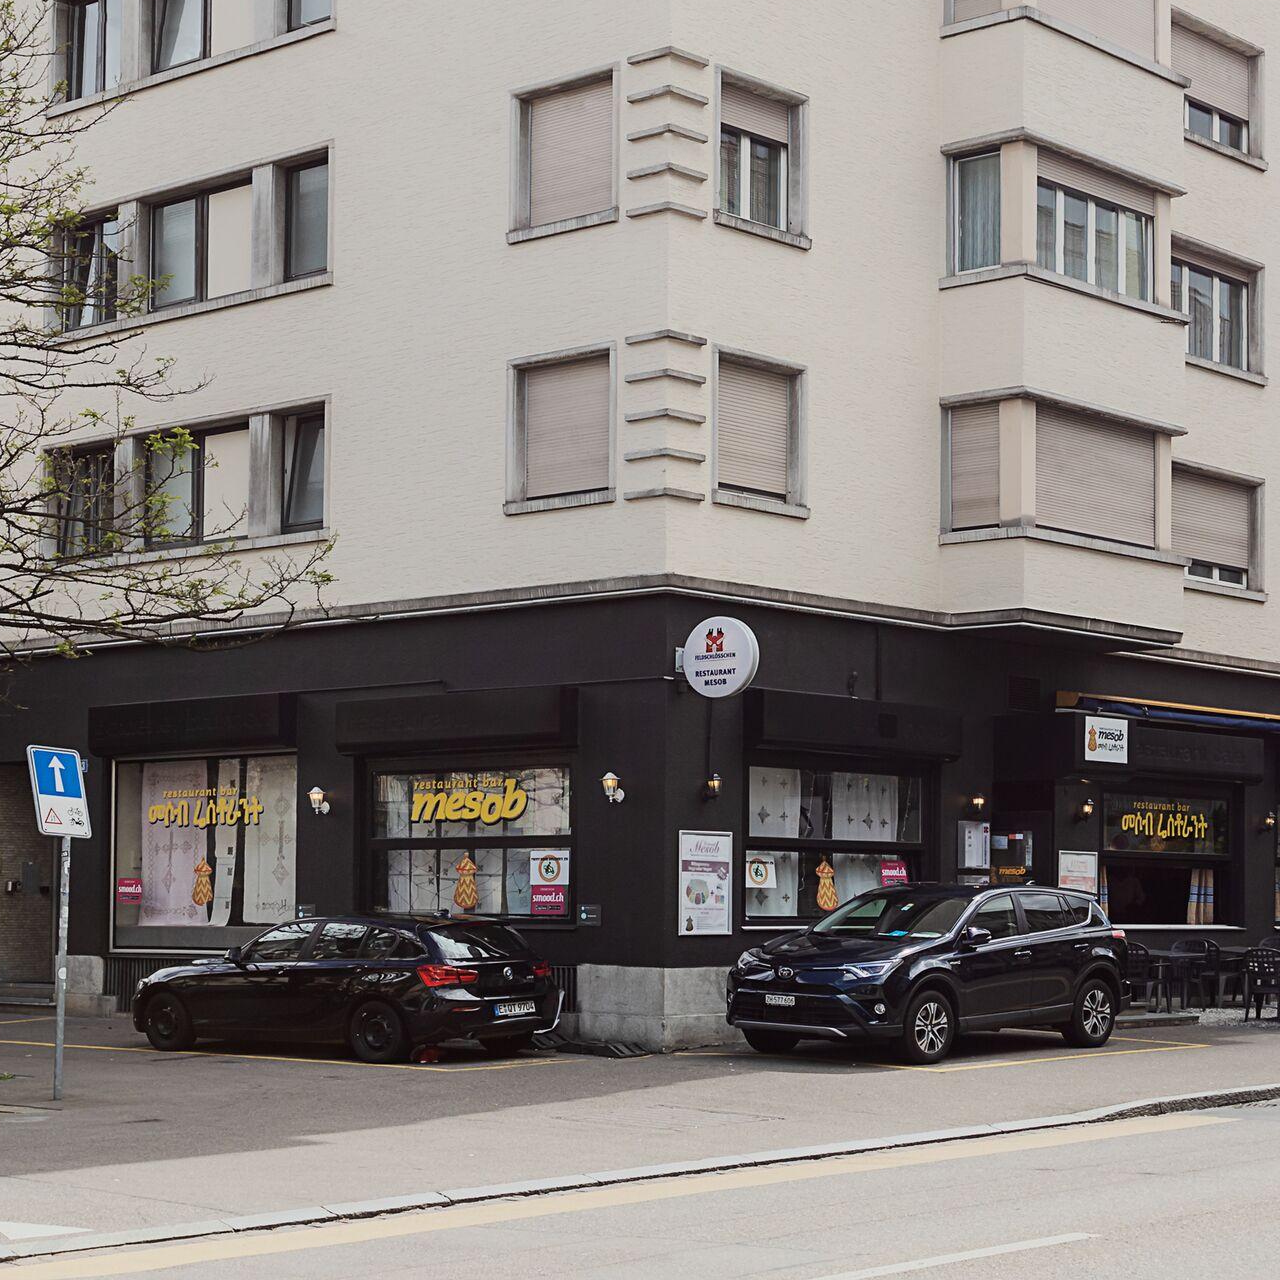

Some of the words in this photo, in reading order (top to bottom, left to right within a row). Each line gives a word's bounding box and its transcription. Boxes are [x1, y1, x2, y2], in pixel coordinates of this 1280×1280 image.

[695, 668, 737, 677] RESTAURANT
[704, 678, 727, 686] MESOB
[1098, 730, 1124, 741] mesob
[414, 778, 478, 790] restaurant
[482, 774, 504, 788] bar
[163, 788, 216, 798] restaurant
[220, 786, 239, 796] bar
[410, 778, 528, 826] mesob
[1133, 801, 1174, 811] restaurant
[1177, 802, 1190, 812] bar
[689, 839, 720, 854] Mesob
[999, 866, 1026, 876] mesob
[118, 884, 142, 893] smood.ch
[532, 892, 564, 902] smood.ch
